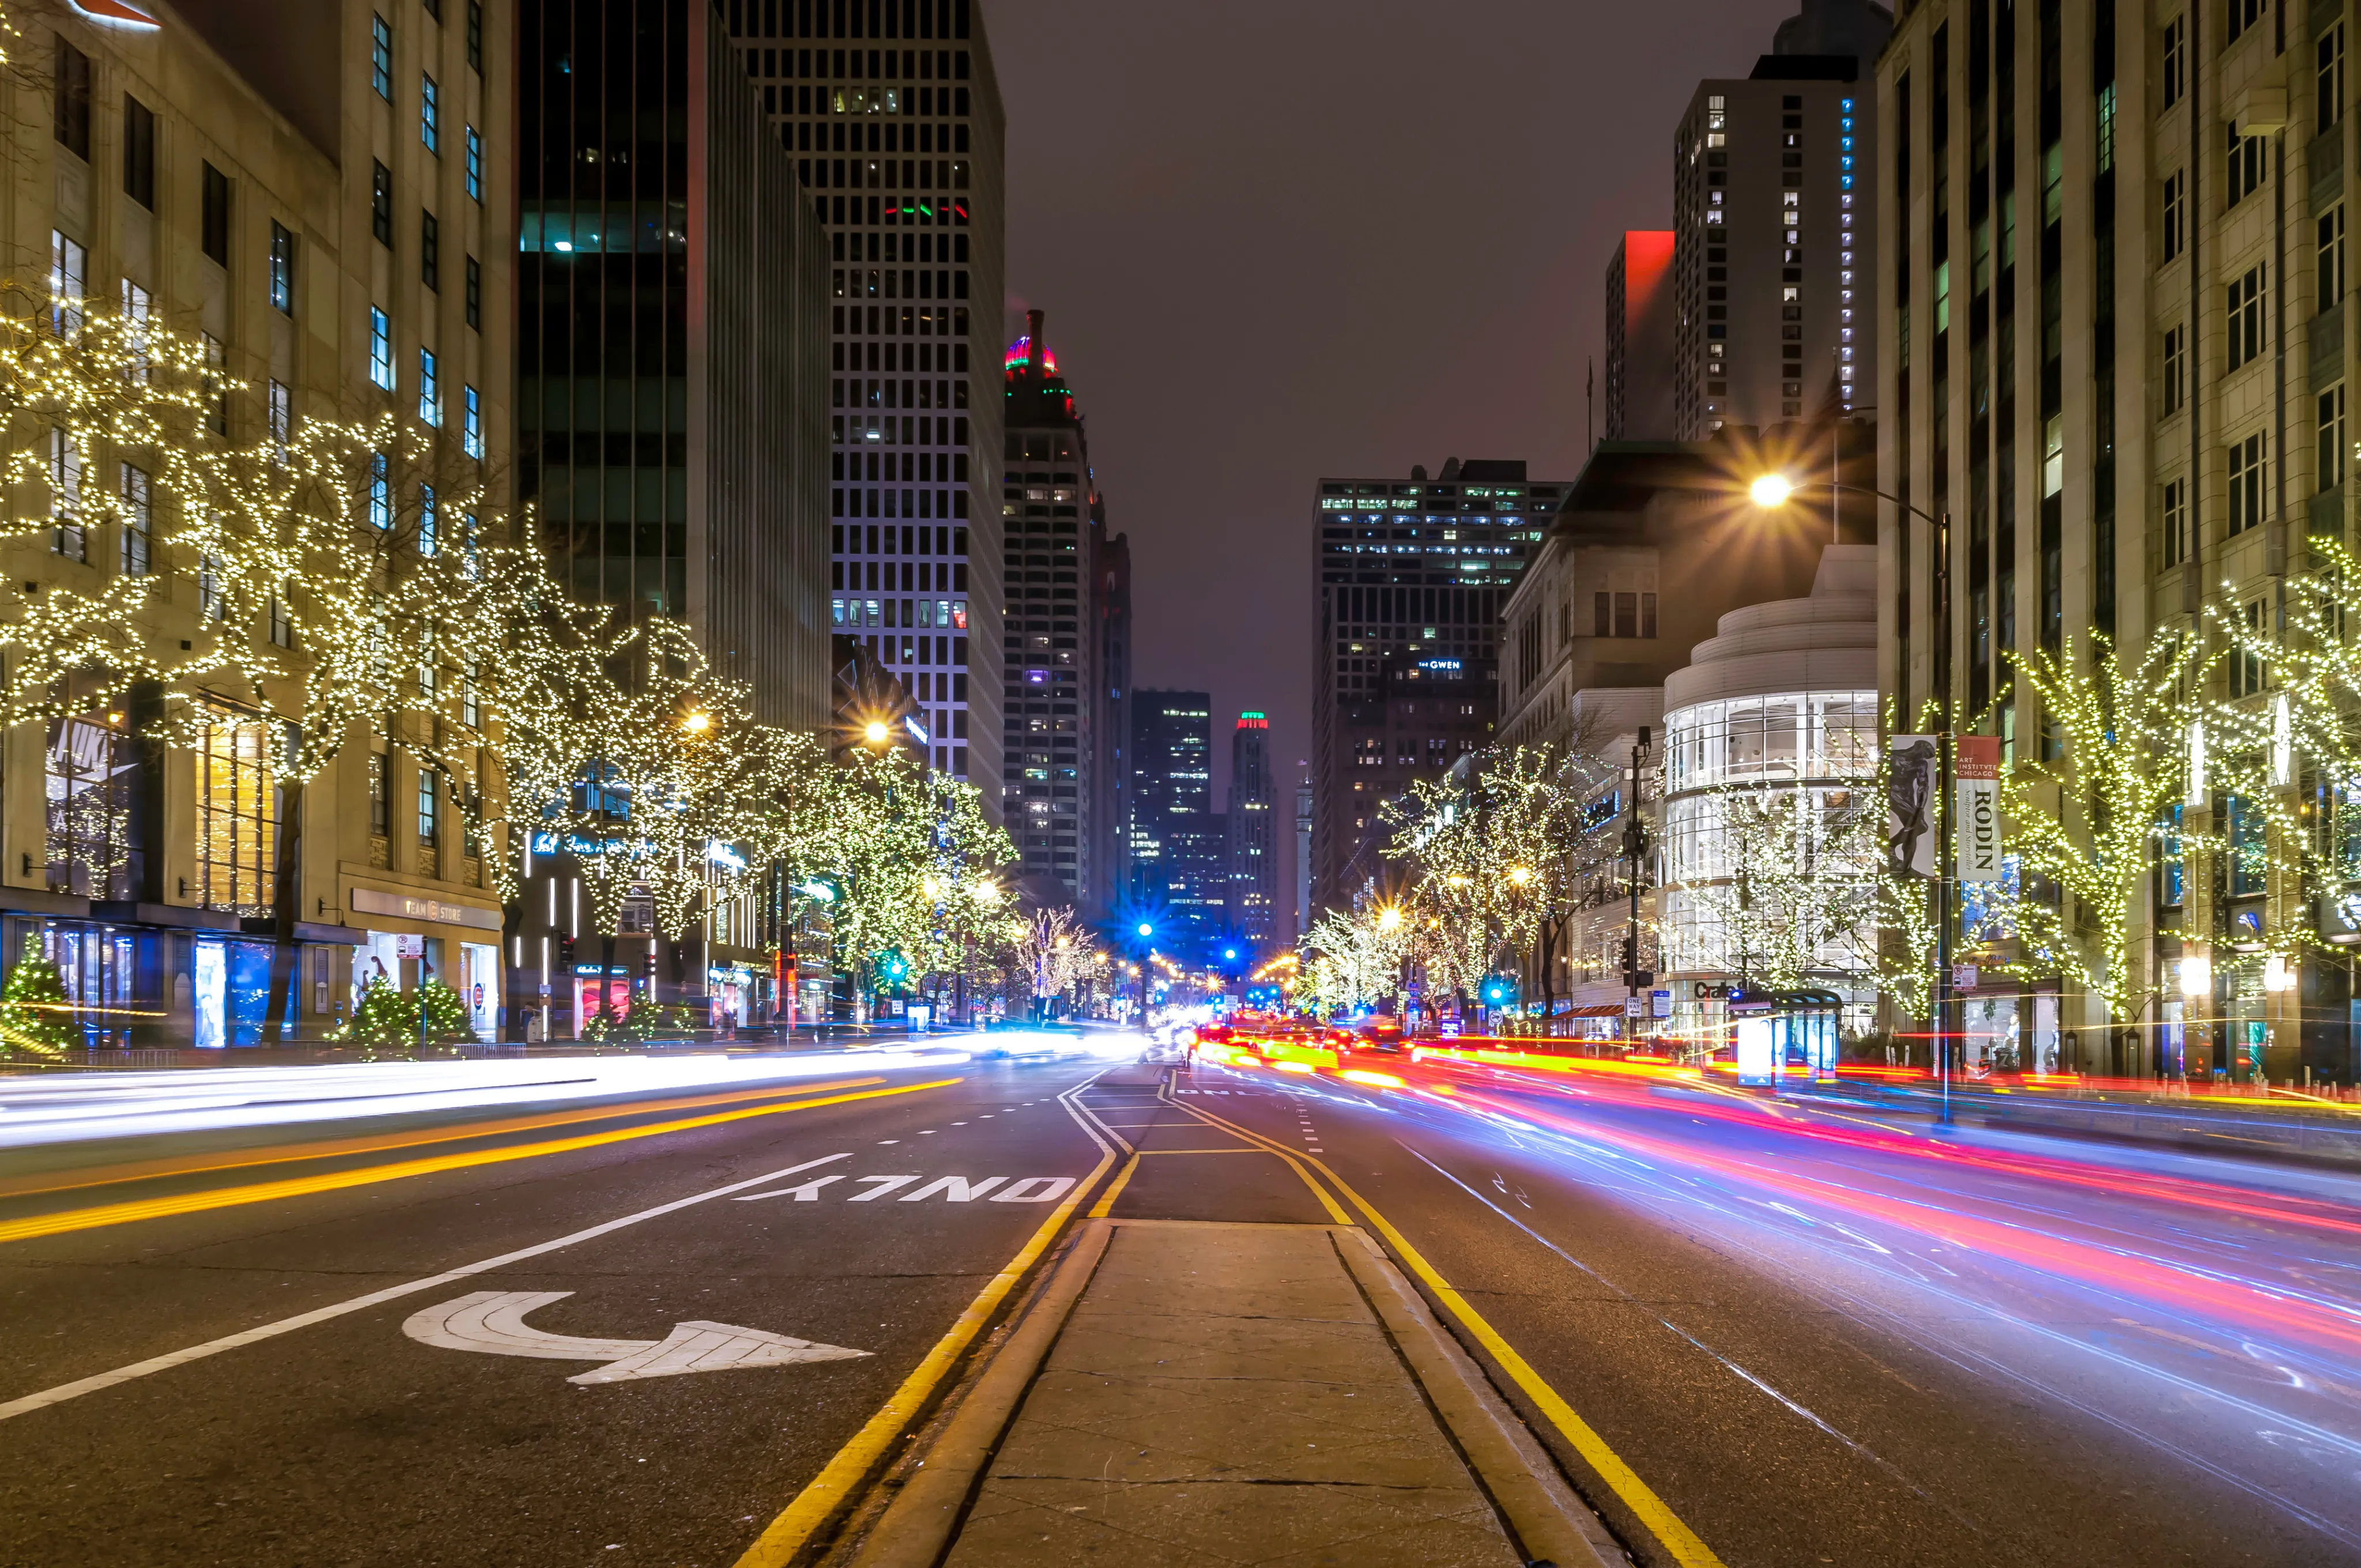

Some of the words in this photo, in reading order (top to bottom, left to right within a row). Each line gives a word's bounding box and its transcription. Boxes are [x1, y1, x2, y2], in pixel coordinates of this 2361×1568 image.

[1430, 661, 1459, 669] GWEN
[46, 719, 118, 771] NIKE
[1963, 789, 1972, 817] Sculptor
[1975, 790, 1993, 871] RODIN
[1964, 835, 1973, 871] Storyteller
[406, 900, 427, 916] TEAM
[440, 907, 461, 921] STORE
[730, 1175, 1077, 1203] ONLY
